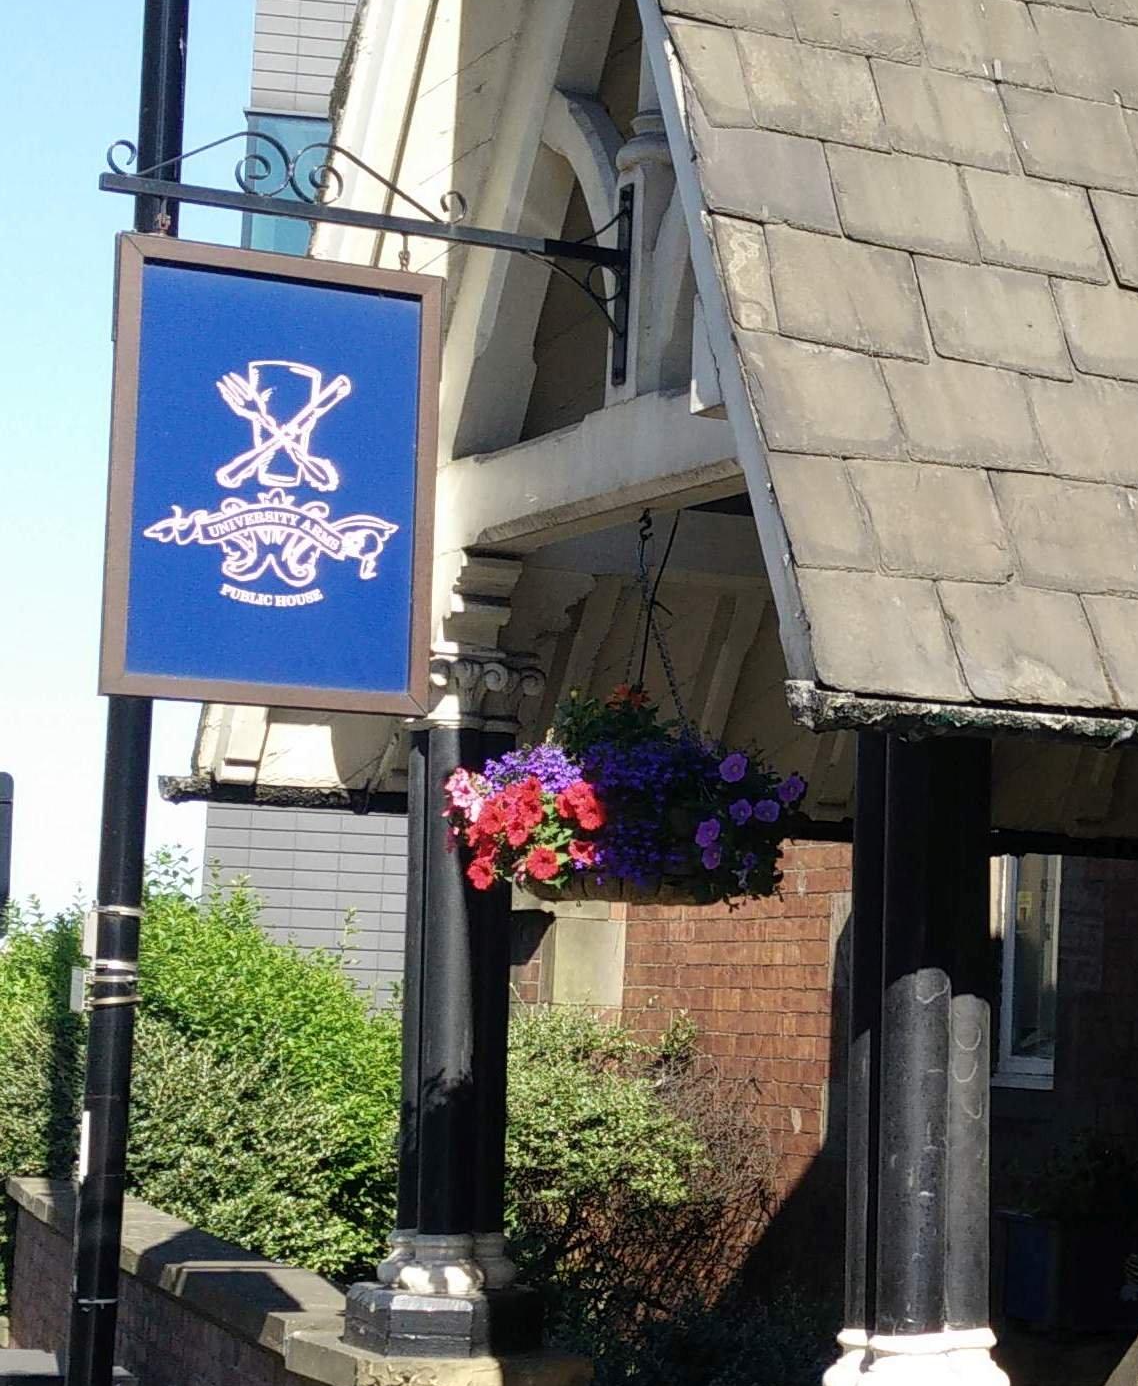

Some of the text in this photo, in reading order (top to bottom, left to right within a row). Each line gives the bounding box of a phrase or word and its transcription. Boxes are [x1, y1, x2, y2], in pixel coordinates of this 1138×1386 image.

[207, 510, 340, 551] UNIVERSITY ARMS
[219, 583, 325, 607] PUBLIC HOUSE
